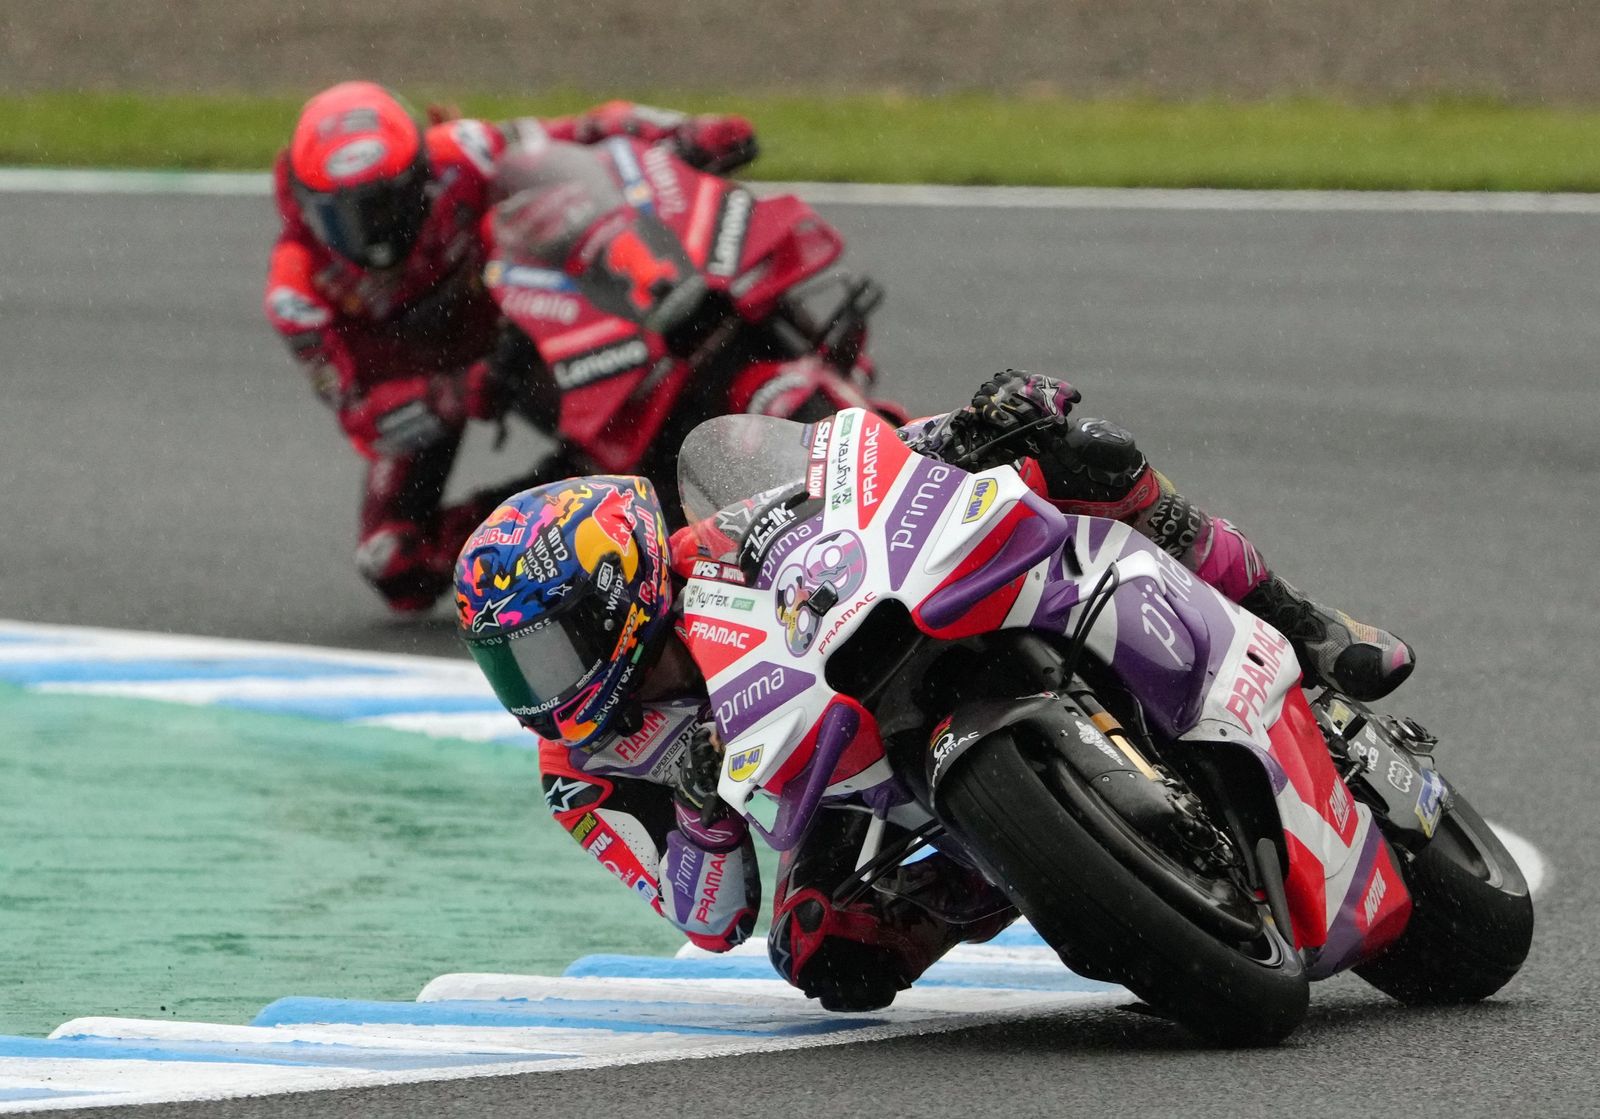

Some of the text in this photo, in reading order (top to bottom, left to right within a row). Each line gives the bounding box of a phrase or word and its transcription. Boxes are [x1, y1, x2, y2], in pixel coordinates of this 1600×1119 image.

[707, 189, 749, 275] Lenovo
[554, 340, 648, 389] Lenovo
[808, 464, 824, 497] MOTUL
[862, 422, 880, 507] PRAMAC
[890, 465, 950, 552] prima
[525, 547, 546, 584] SOCIAL
[533, 535, 558, 578] SOCIAL
[547, 526, 569, 562] CLUB
[692, 560, 720, 577] WRS
[761, 523, 813, 581] prima
[697, 586, 730, 608] kyrrex
[722, 566, 745, 583] MOTUL
[507, 617, 553, 640] WINGS
[689, 620, 750, 650] PRAMAC
[818, 591, 877, 655] PRAMAC
[602, 664, 634, 716] kyrrex
[715, 667, 785, 734] prima
[1225, 618, 1287, 736] PRAMAC
[614, 709, 667, 762] FIAMM
[731, 748, 761, 772] WD-40
[675, 846, 697, 899] prima
[1363, 867, 1387, 928] MOTUL
